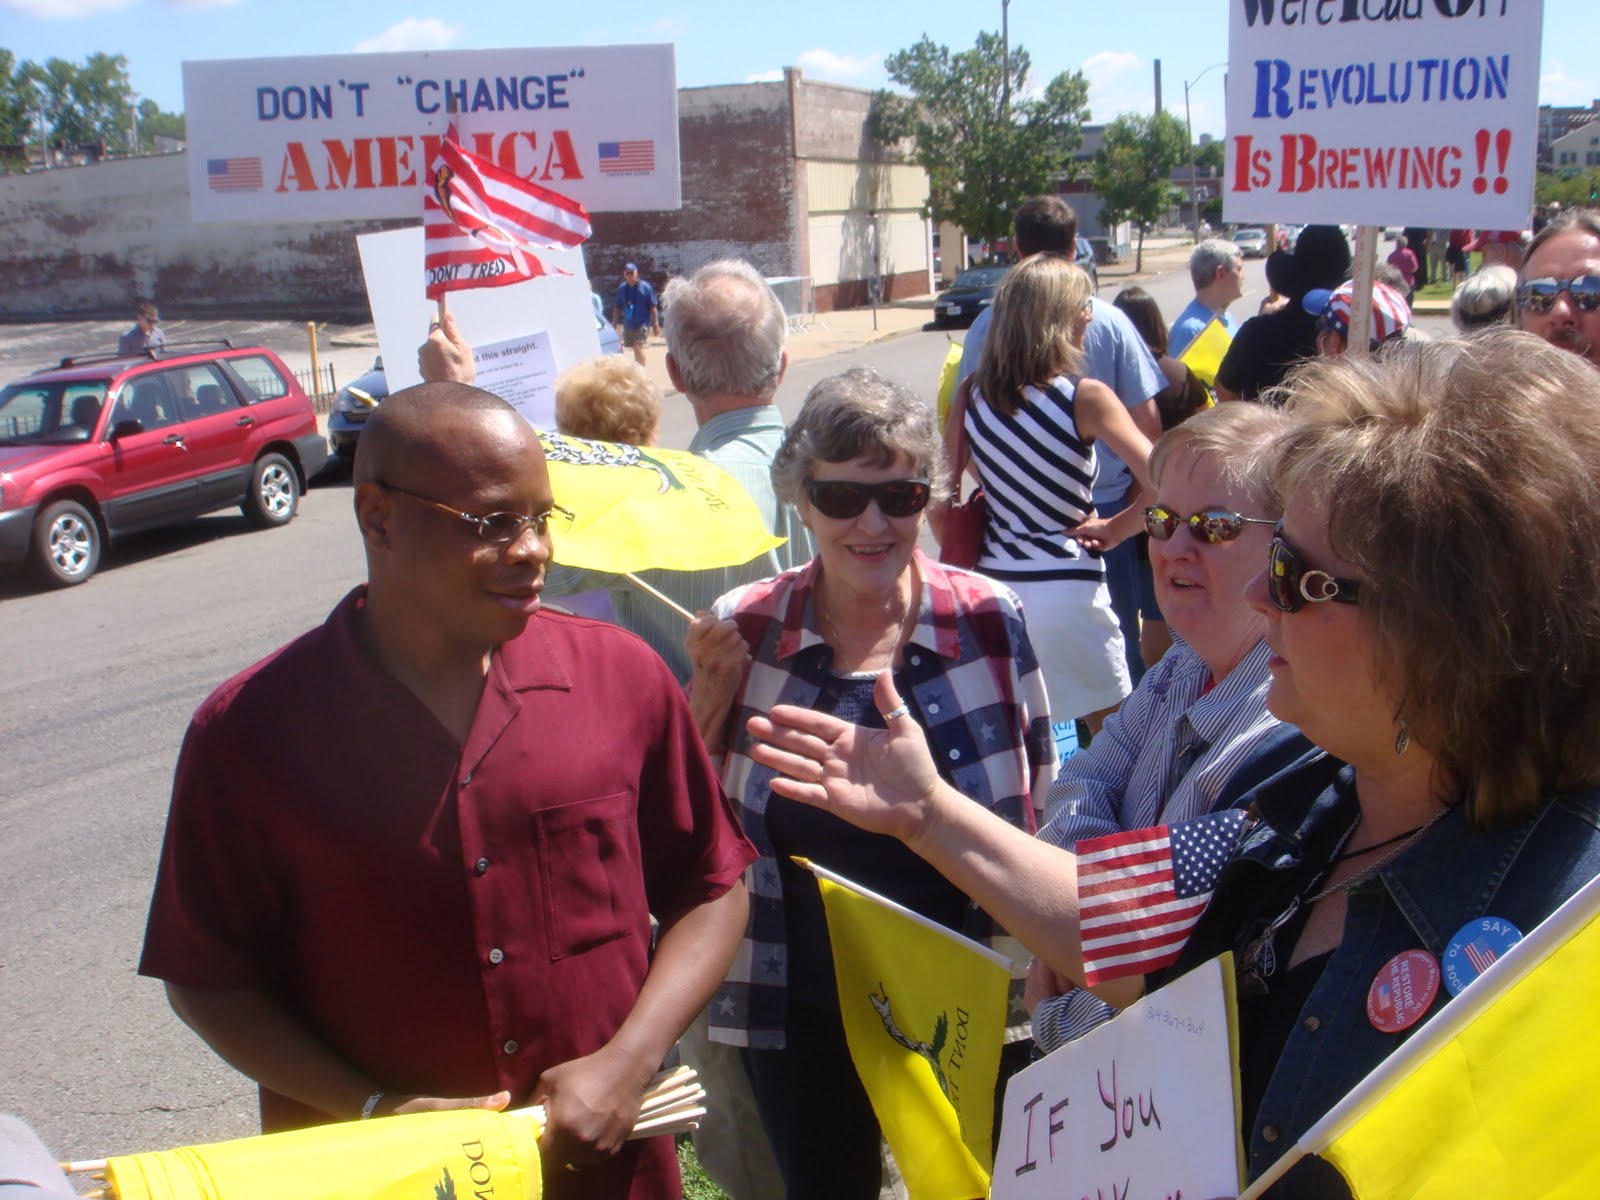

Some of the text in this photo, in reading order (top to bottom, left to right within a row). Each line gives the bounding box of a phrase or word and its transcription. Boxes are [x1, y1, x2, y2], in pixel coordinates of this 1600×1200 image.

[256, 79, 370, 121] DON'T
[1252, 55, 1510, 119] REVOLUTION
[481, 350, 500, 362] this
[501, 342, 539, 357] straight.
[1449, 943, 1461, 958] TO
[1481, 920, 1511, 936] SAY
[1390, 956, 1405, 1024] THE REPUBLIC
[1400, 960, 1414, 1009] RESTORE
[1015, 1091, 1069, 1177] IF
